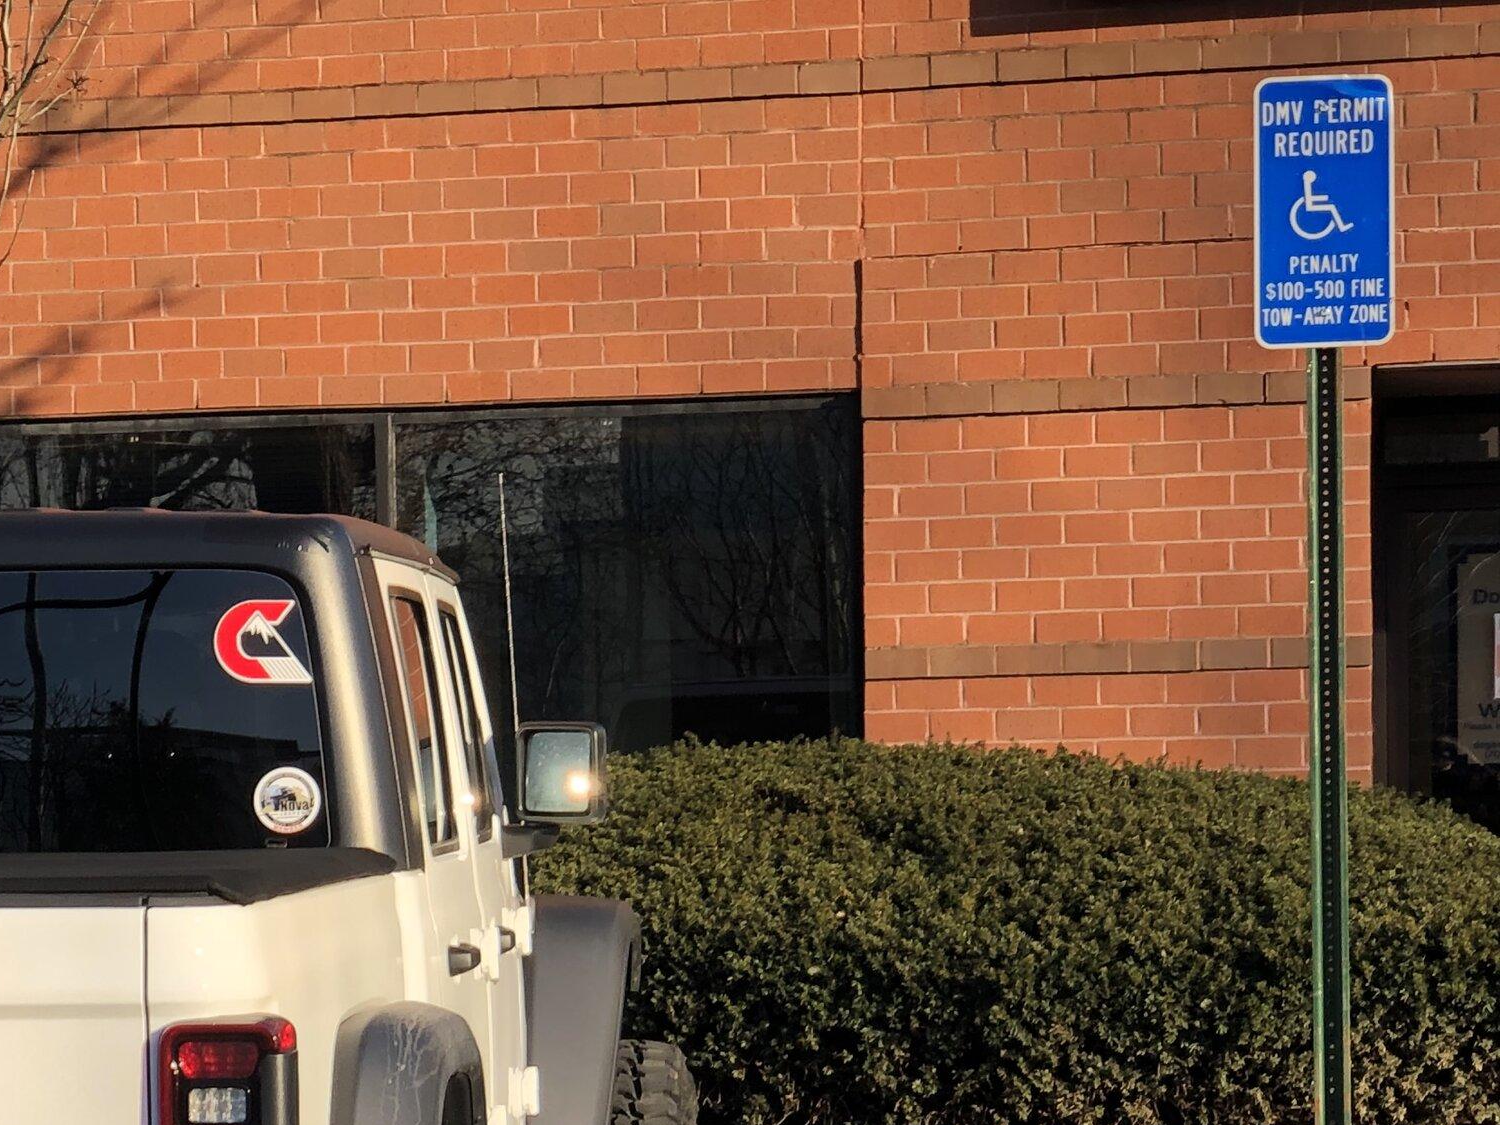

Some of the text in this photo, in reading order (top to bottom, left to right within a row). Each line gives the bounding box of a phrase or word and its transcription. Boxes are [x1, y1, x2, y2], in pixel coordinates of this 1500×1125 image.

[1262, 97, 1385, 127] DMV PERMIT
[1274, 128, 1374, 158] REQUIRED
[1289, 253, 1359, 275] PENALTY
[1266, 278, 1385, 301] $100-500 FINE
[1262, 304, 1388, 328] TOW-AWAY ZONE
